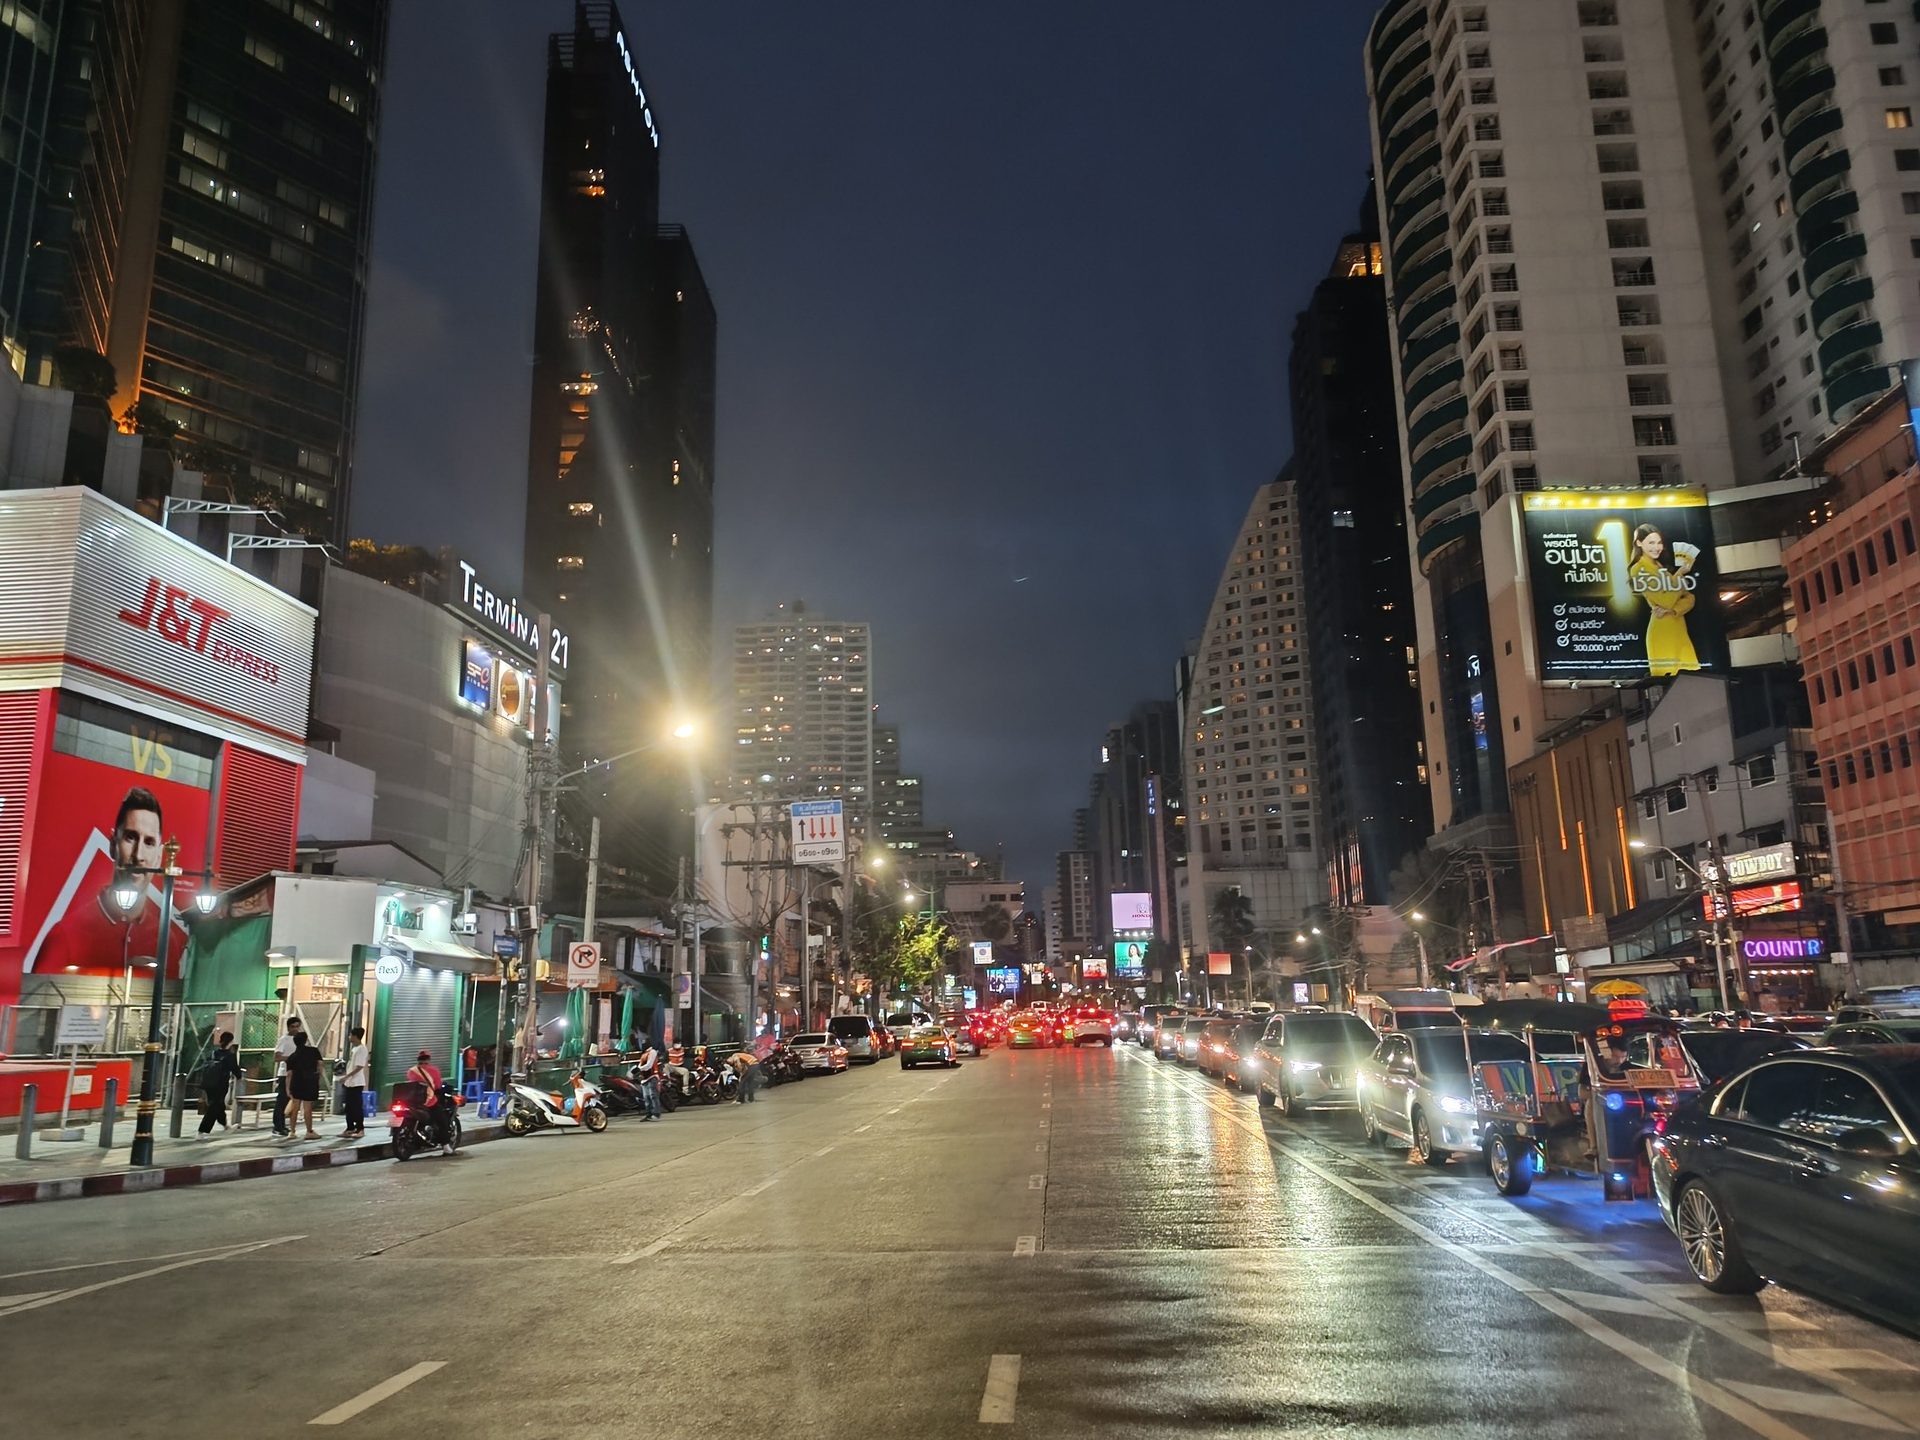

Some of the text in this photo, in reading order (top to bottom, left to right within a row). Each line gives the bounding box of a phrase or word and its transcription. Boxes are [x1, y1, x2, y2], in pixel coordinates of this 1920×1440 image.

[1544, 544, 1606, 568] อนุมัติ
[1564, 568, 1608, 583] ทันใจใน
[460, 560, 569, 669] TERMiNA 21
[117, 576, 281, 685] J&T EXPRESS
[1729, 852, 1783, 877] COWBOY
